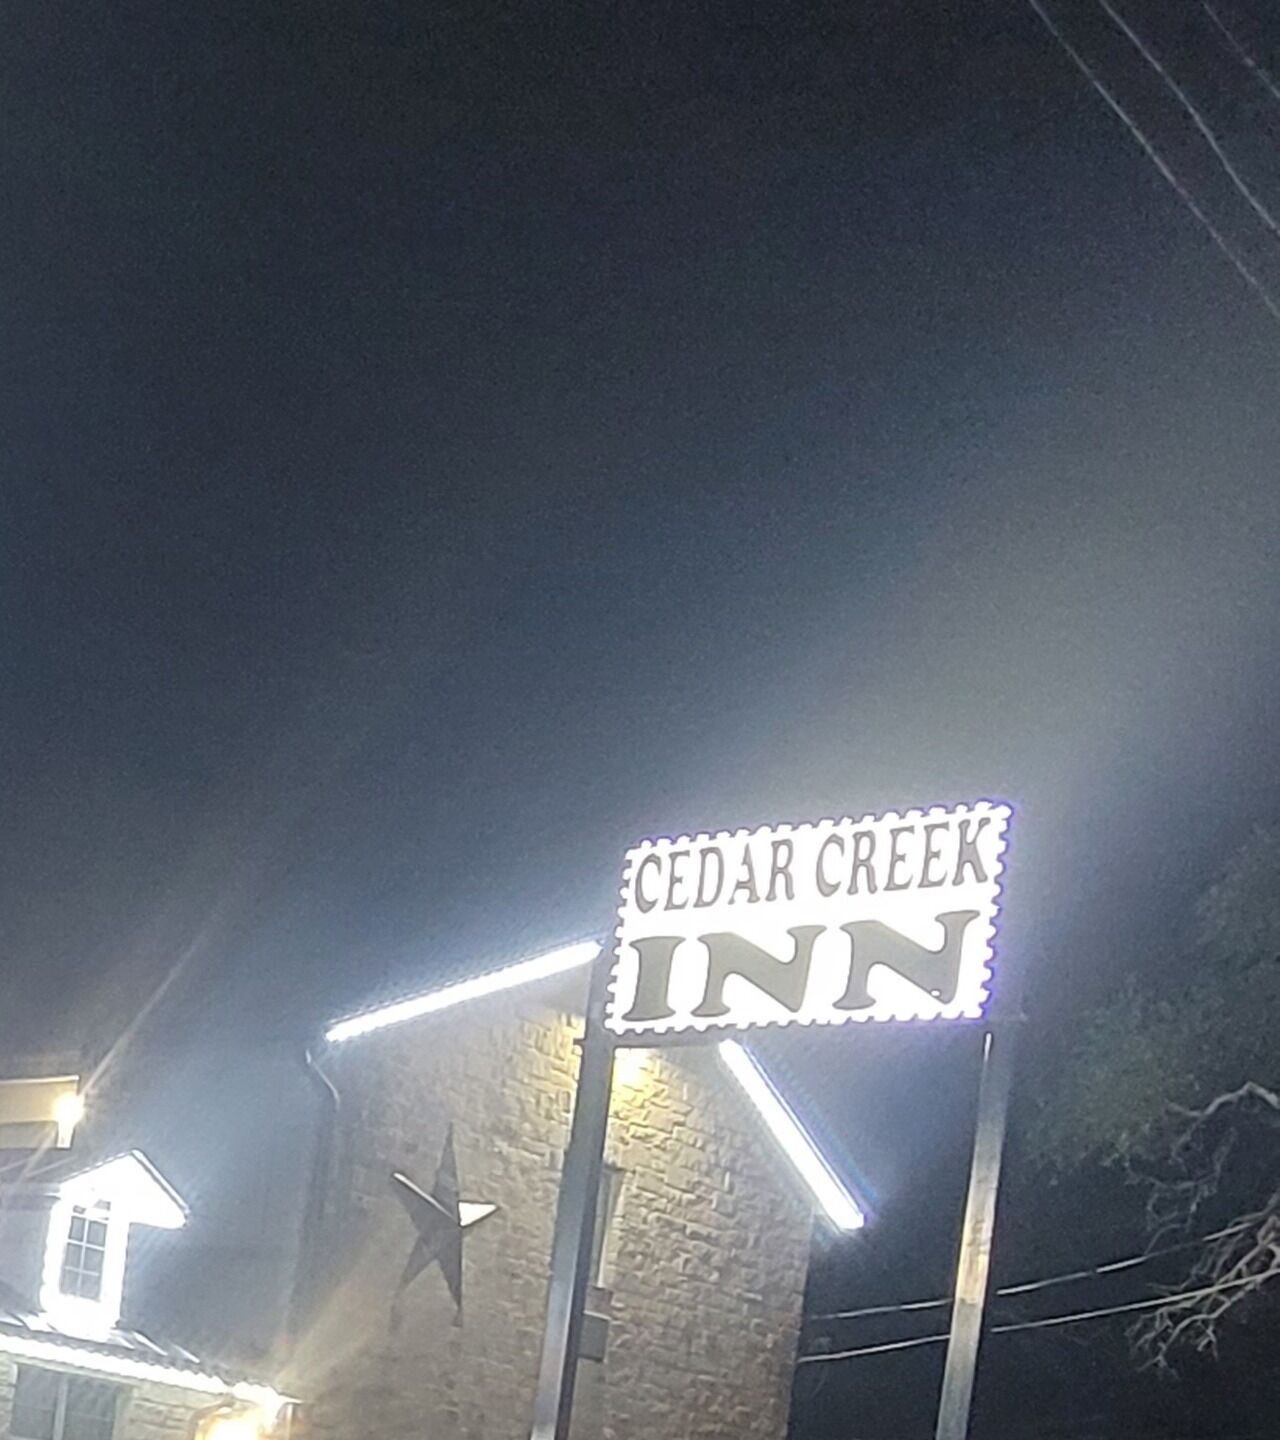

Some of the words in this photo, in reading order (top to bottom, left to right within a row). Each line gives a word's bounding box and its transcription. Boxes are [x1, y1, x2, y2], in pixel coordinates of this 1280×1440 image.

[636, 839, 794, 913] CEDAR
[816, 818, 992, 897] CREEK
[622, 910, 980, 1022] INN
